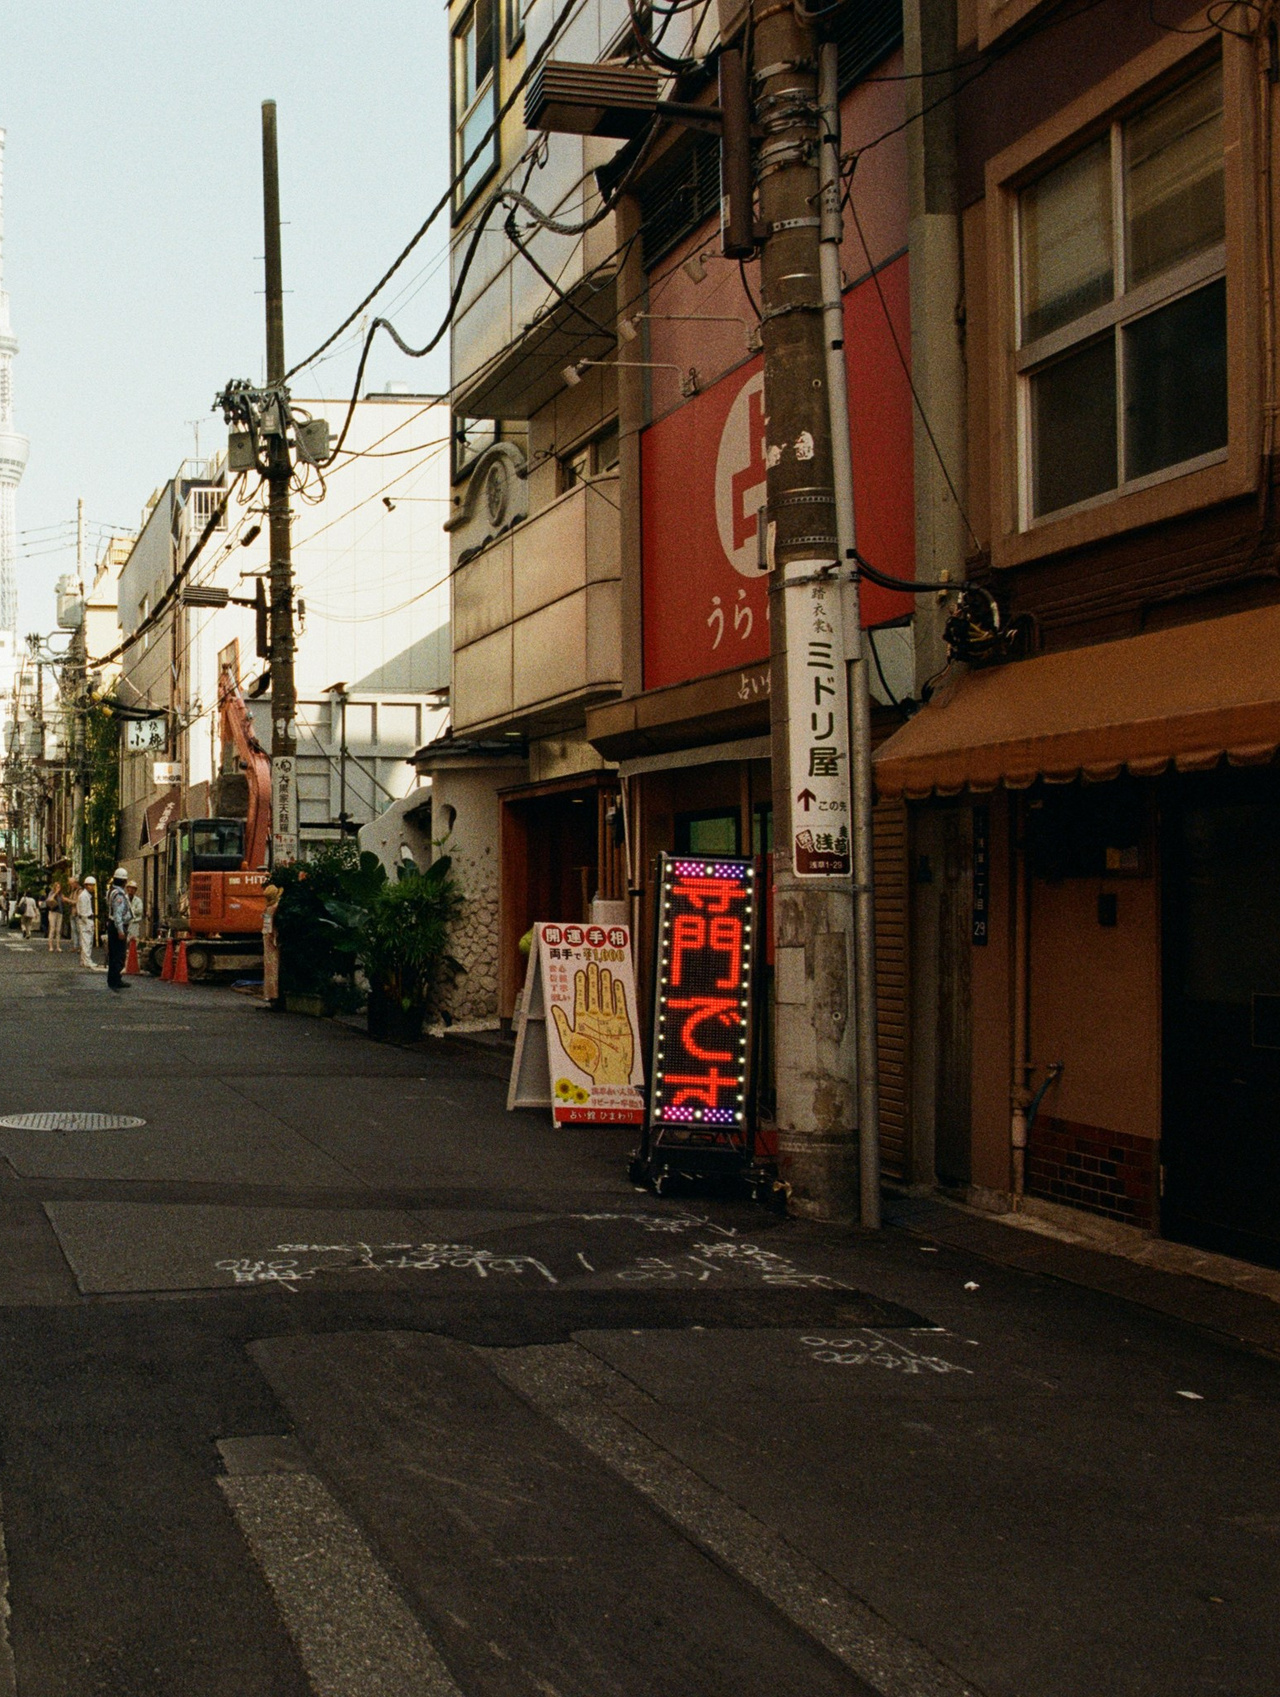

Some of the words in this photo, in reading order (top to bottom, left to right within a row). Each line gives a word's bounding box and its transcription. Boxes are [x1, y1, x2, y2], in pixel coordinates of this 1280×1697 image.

[707, 589, 770, 650] うら
[807, 642, 839, 777] ミドリ屋
[818, 801, 847, 811] この先
[809, 860, 842, 869] 浅草1-29
[974, 921, 986, 936] 29
[546, 928, 625, 945] 開運手相
[551, 948, 582, 960] 両手で
[600, 1111, 634, 1121] ひまわり
